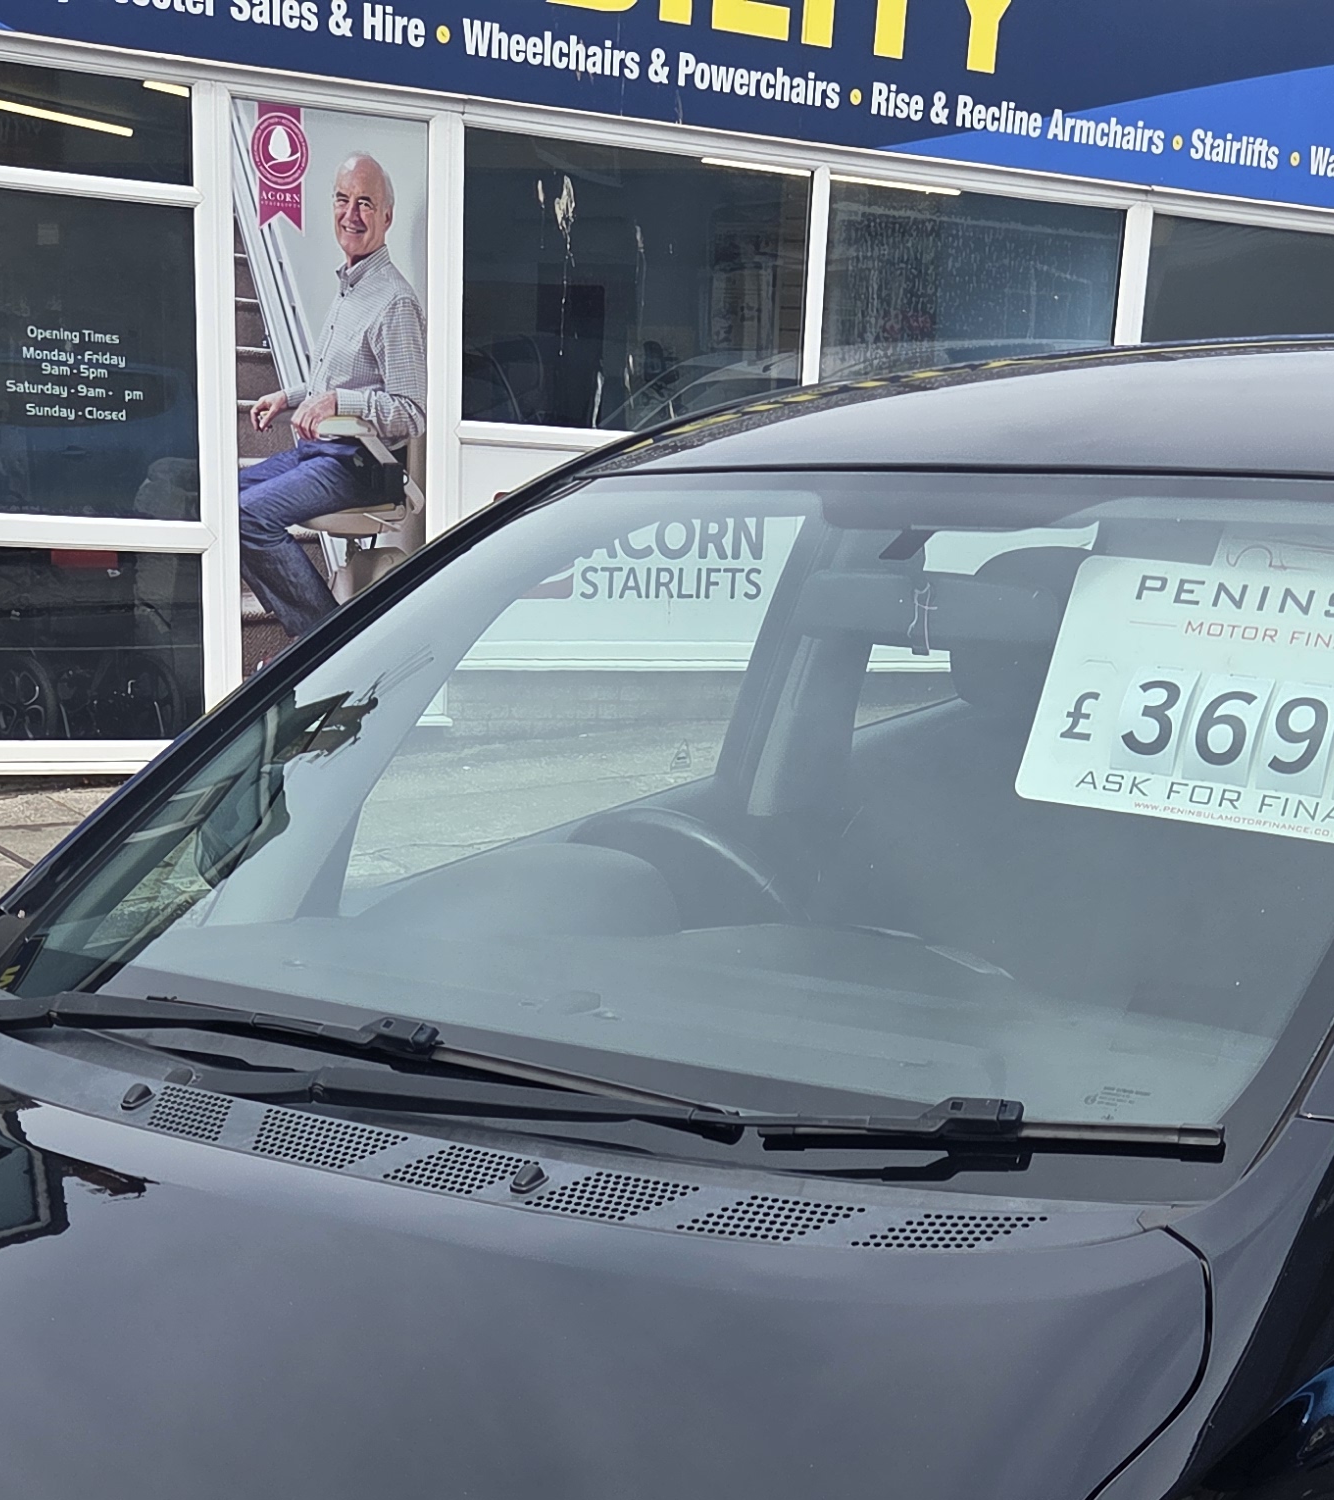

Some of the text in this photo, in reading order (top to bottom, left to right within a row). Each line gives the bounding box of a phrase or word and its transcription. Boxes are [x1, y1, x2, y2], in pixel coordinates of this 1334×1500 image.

[229, 0, 318, 32] Sales
[328, 0, 353, 37] &
[363, 2, 426, 48] Hire
[462, 17, 640, 81] Wheelchairs
[647, 47, 670, 84] &
[677, 51, 841, 110] Powerchairs
[870, 81, 924, 122] Rise
[929, 91, 950, 125] &
[955, 94, 1043, 138] Recline
[1047, 108, 1165, 155] Armchairs
[1189, 128, 1280, 170] Stairlifts
[260, 190, 300, 202] ACORN
[26, 325, 120, 344] Opening Times
[22, 346, 74, 364] Monday
[84, 351, 126, 368] Friday
[41, 362, 70, 376] 9am
[79, 365, 108, 380] 5pm
[5, 379, 68, 398] Saturday
[77, 384, 106, 398] 9am
[124, 389, 144, 402] pm
[25, 403, 75, 420] Sunday
[84, 407, 127, 421] Closed
[593, 516, 765, 560] CORN
[579, 565, 762, 600] STAIRLIFTS
[1184, 620, 1279, 644] MOTOR
[1059, 691, 1101, 742] £
[1075, 770, 1152, 797] ASK
[1167, 781, 1242, 810] FOR
